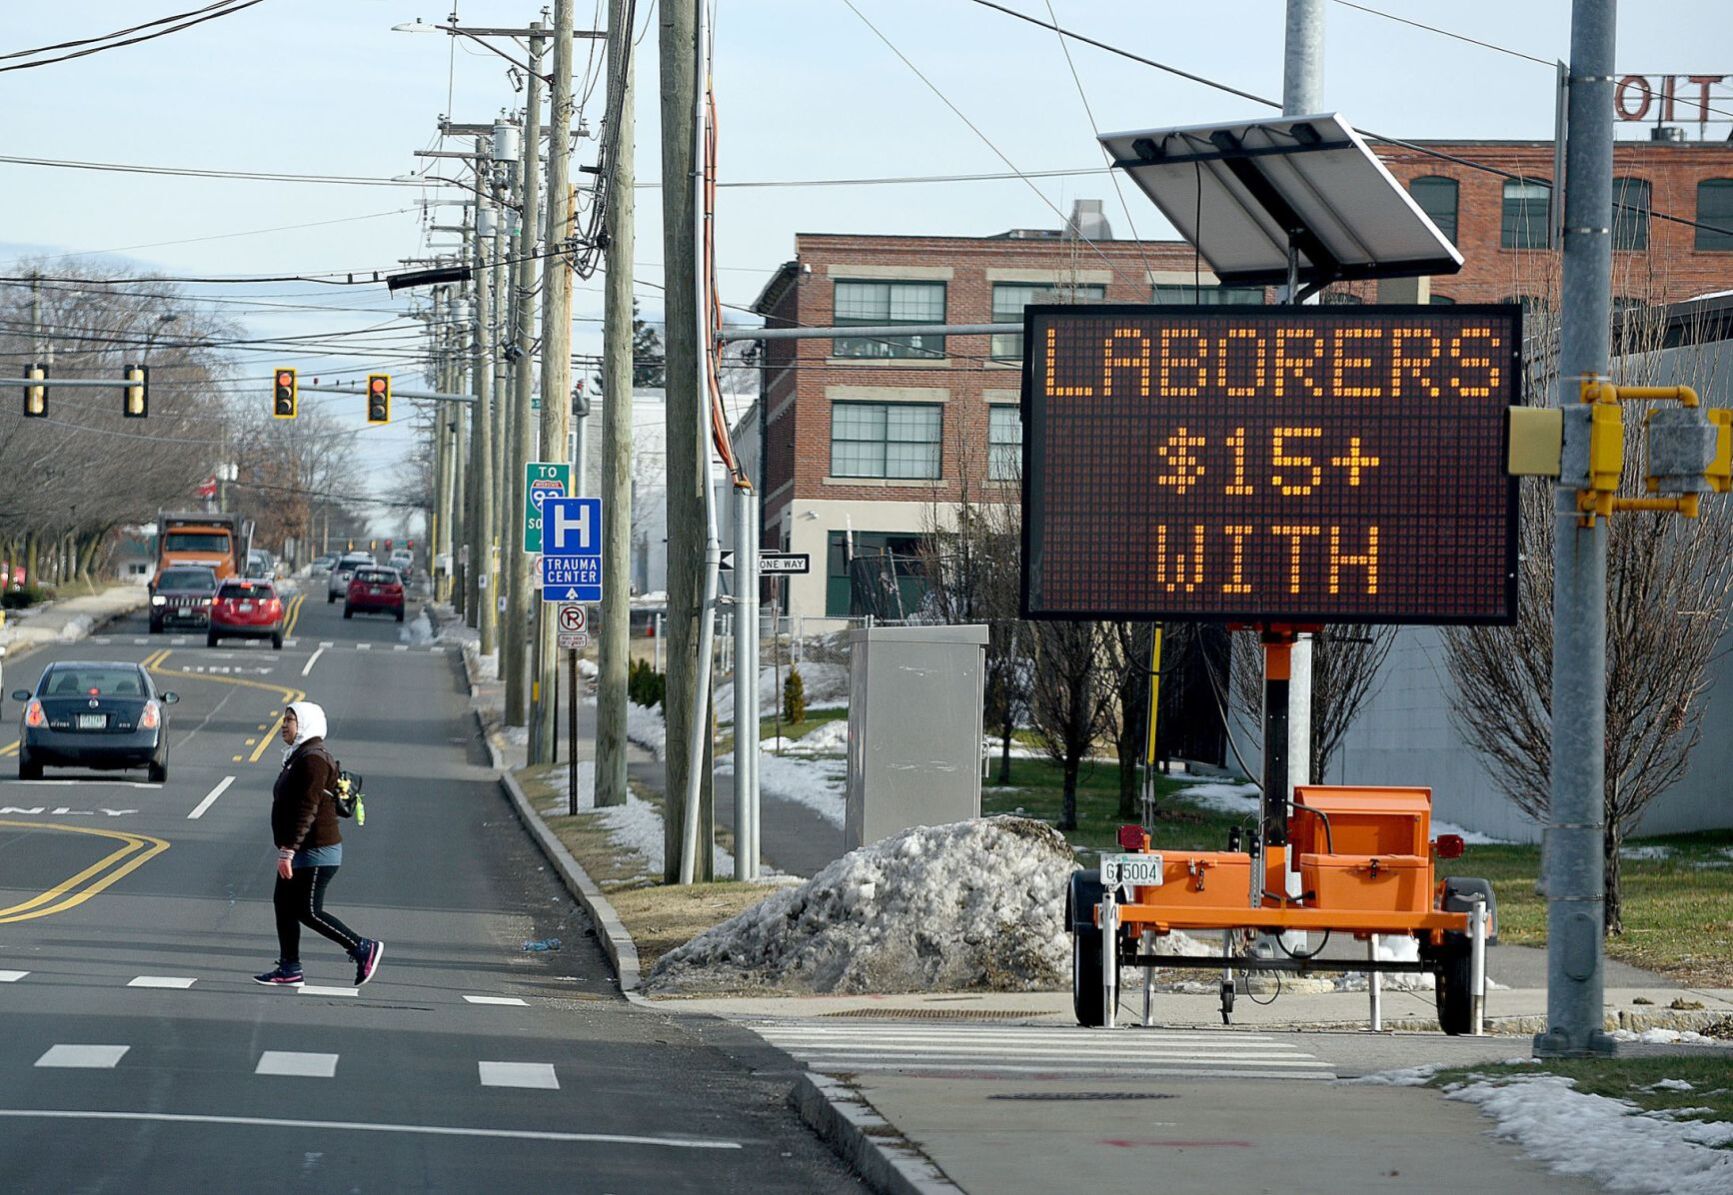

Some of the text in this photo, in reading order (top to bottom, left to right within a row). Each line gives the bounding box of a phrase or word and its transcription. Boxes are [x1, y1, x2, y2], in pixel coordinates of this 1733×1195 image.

[1046, 328, 1500, 398] LABORERS
[538, 466, 557, 478] TO
[1158, 427, 1380, 495] $15+
[554, 504, 590, 548] H
[547, 558, 597, 571] TRAUMA
[760, 560, 804, 569] ONE WAY
[1157, 524, 1379, 594] WITH
[547, 571, 597, 583] CENTER
